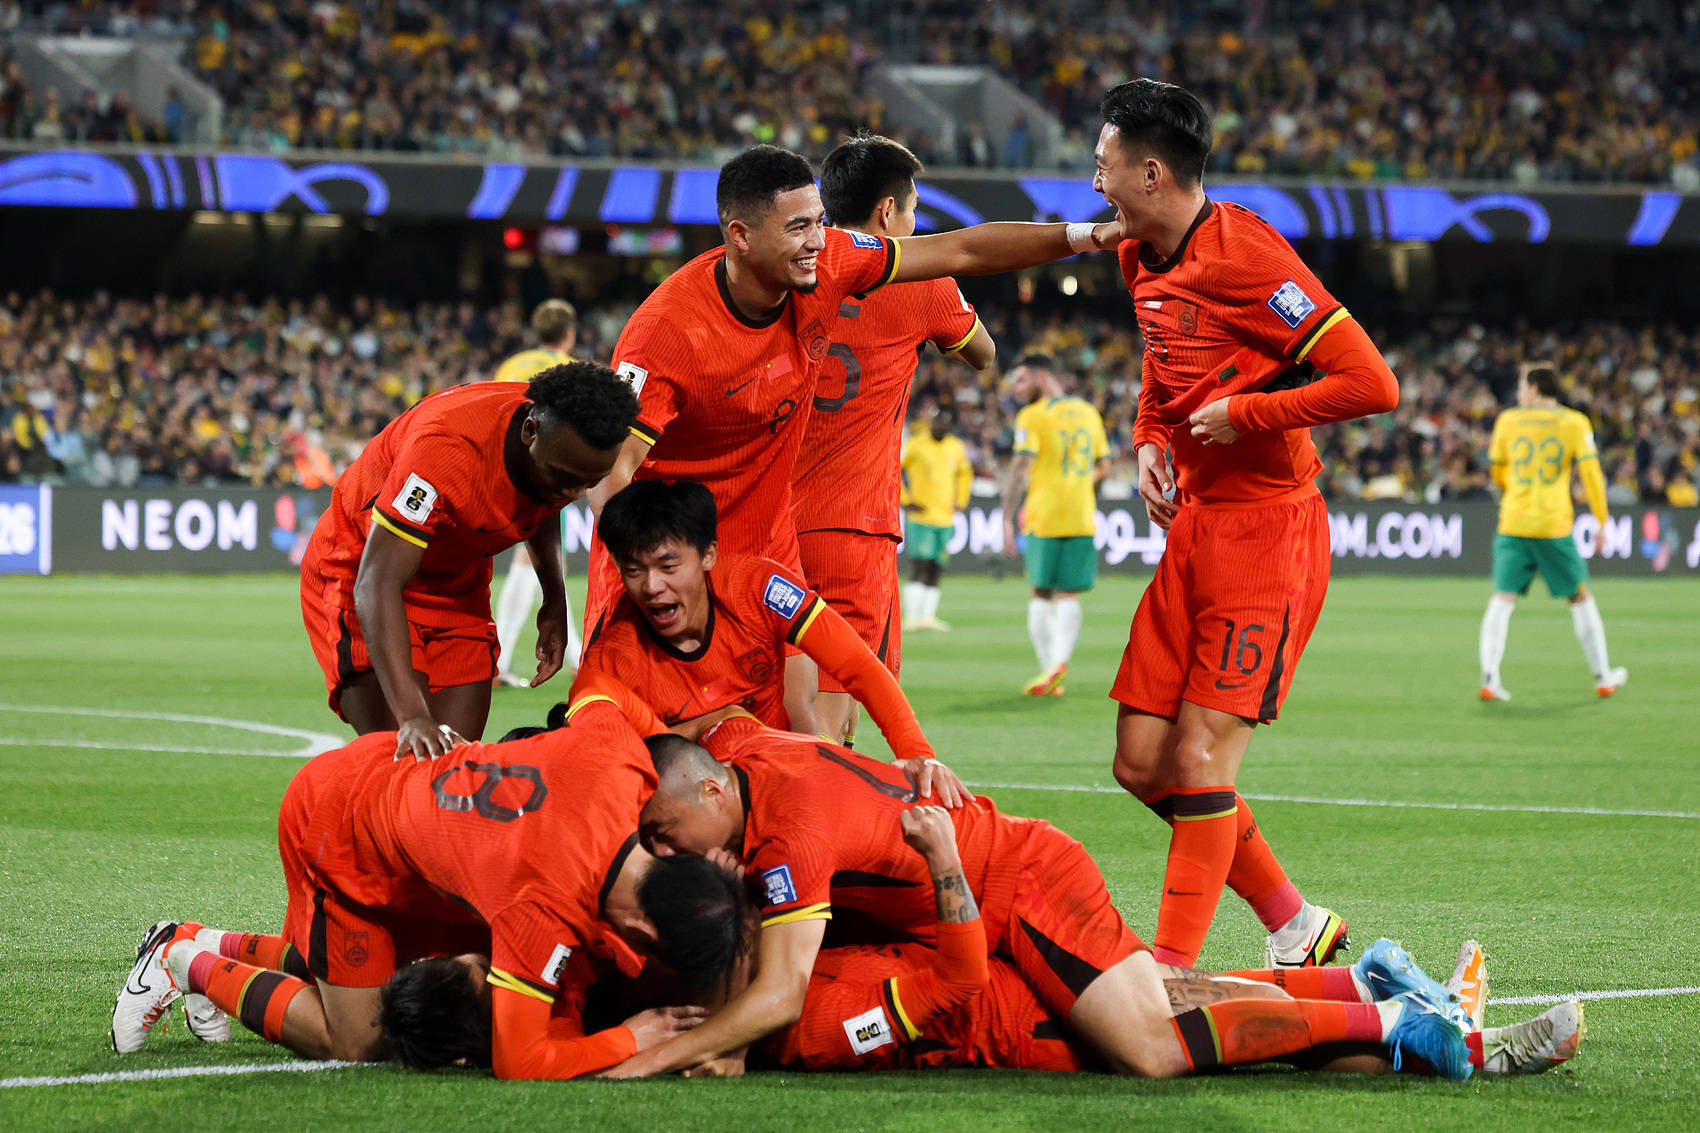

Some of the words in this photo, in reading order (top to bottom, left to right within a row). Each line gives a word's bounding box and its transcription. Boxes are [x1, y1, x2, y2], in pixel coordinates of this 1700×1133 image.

[1059, 427, 1094, 477] 13
[1513, 435, 1565, 486] 23
[102, 499, 258, 551] NEOM
[1573, 512, 1632, 558] OM
[1220, 620, 1265, 676] 16
[431, 760, 548, 823] 8
